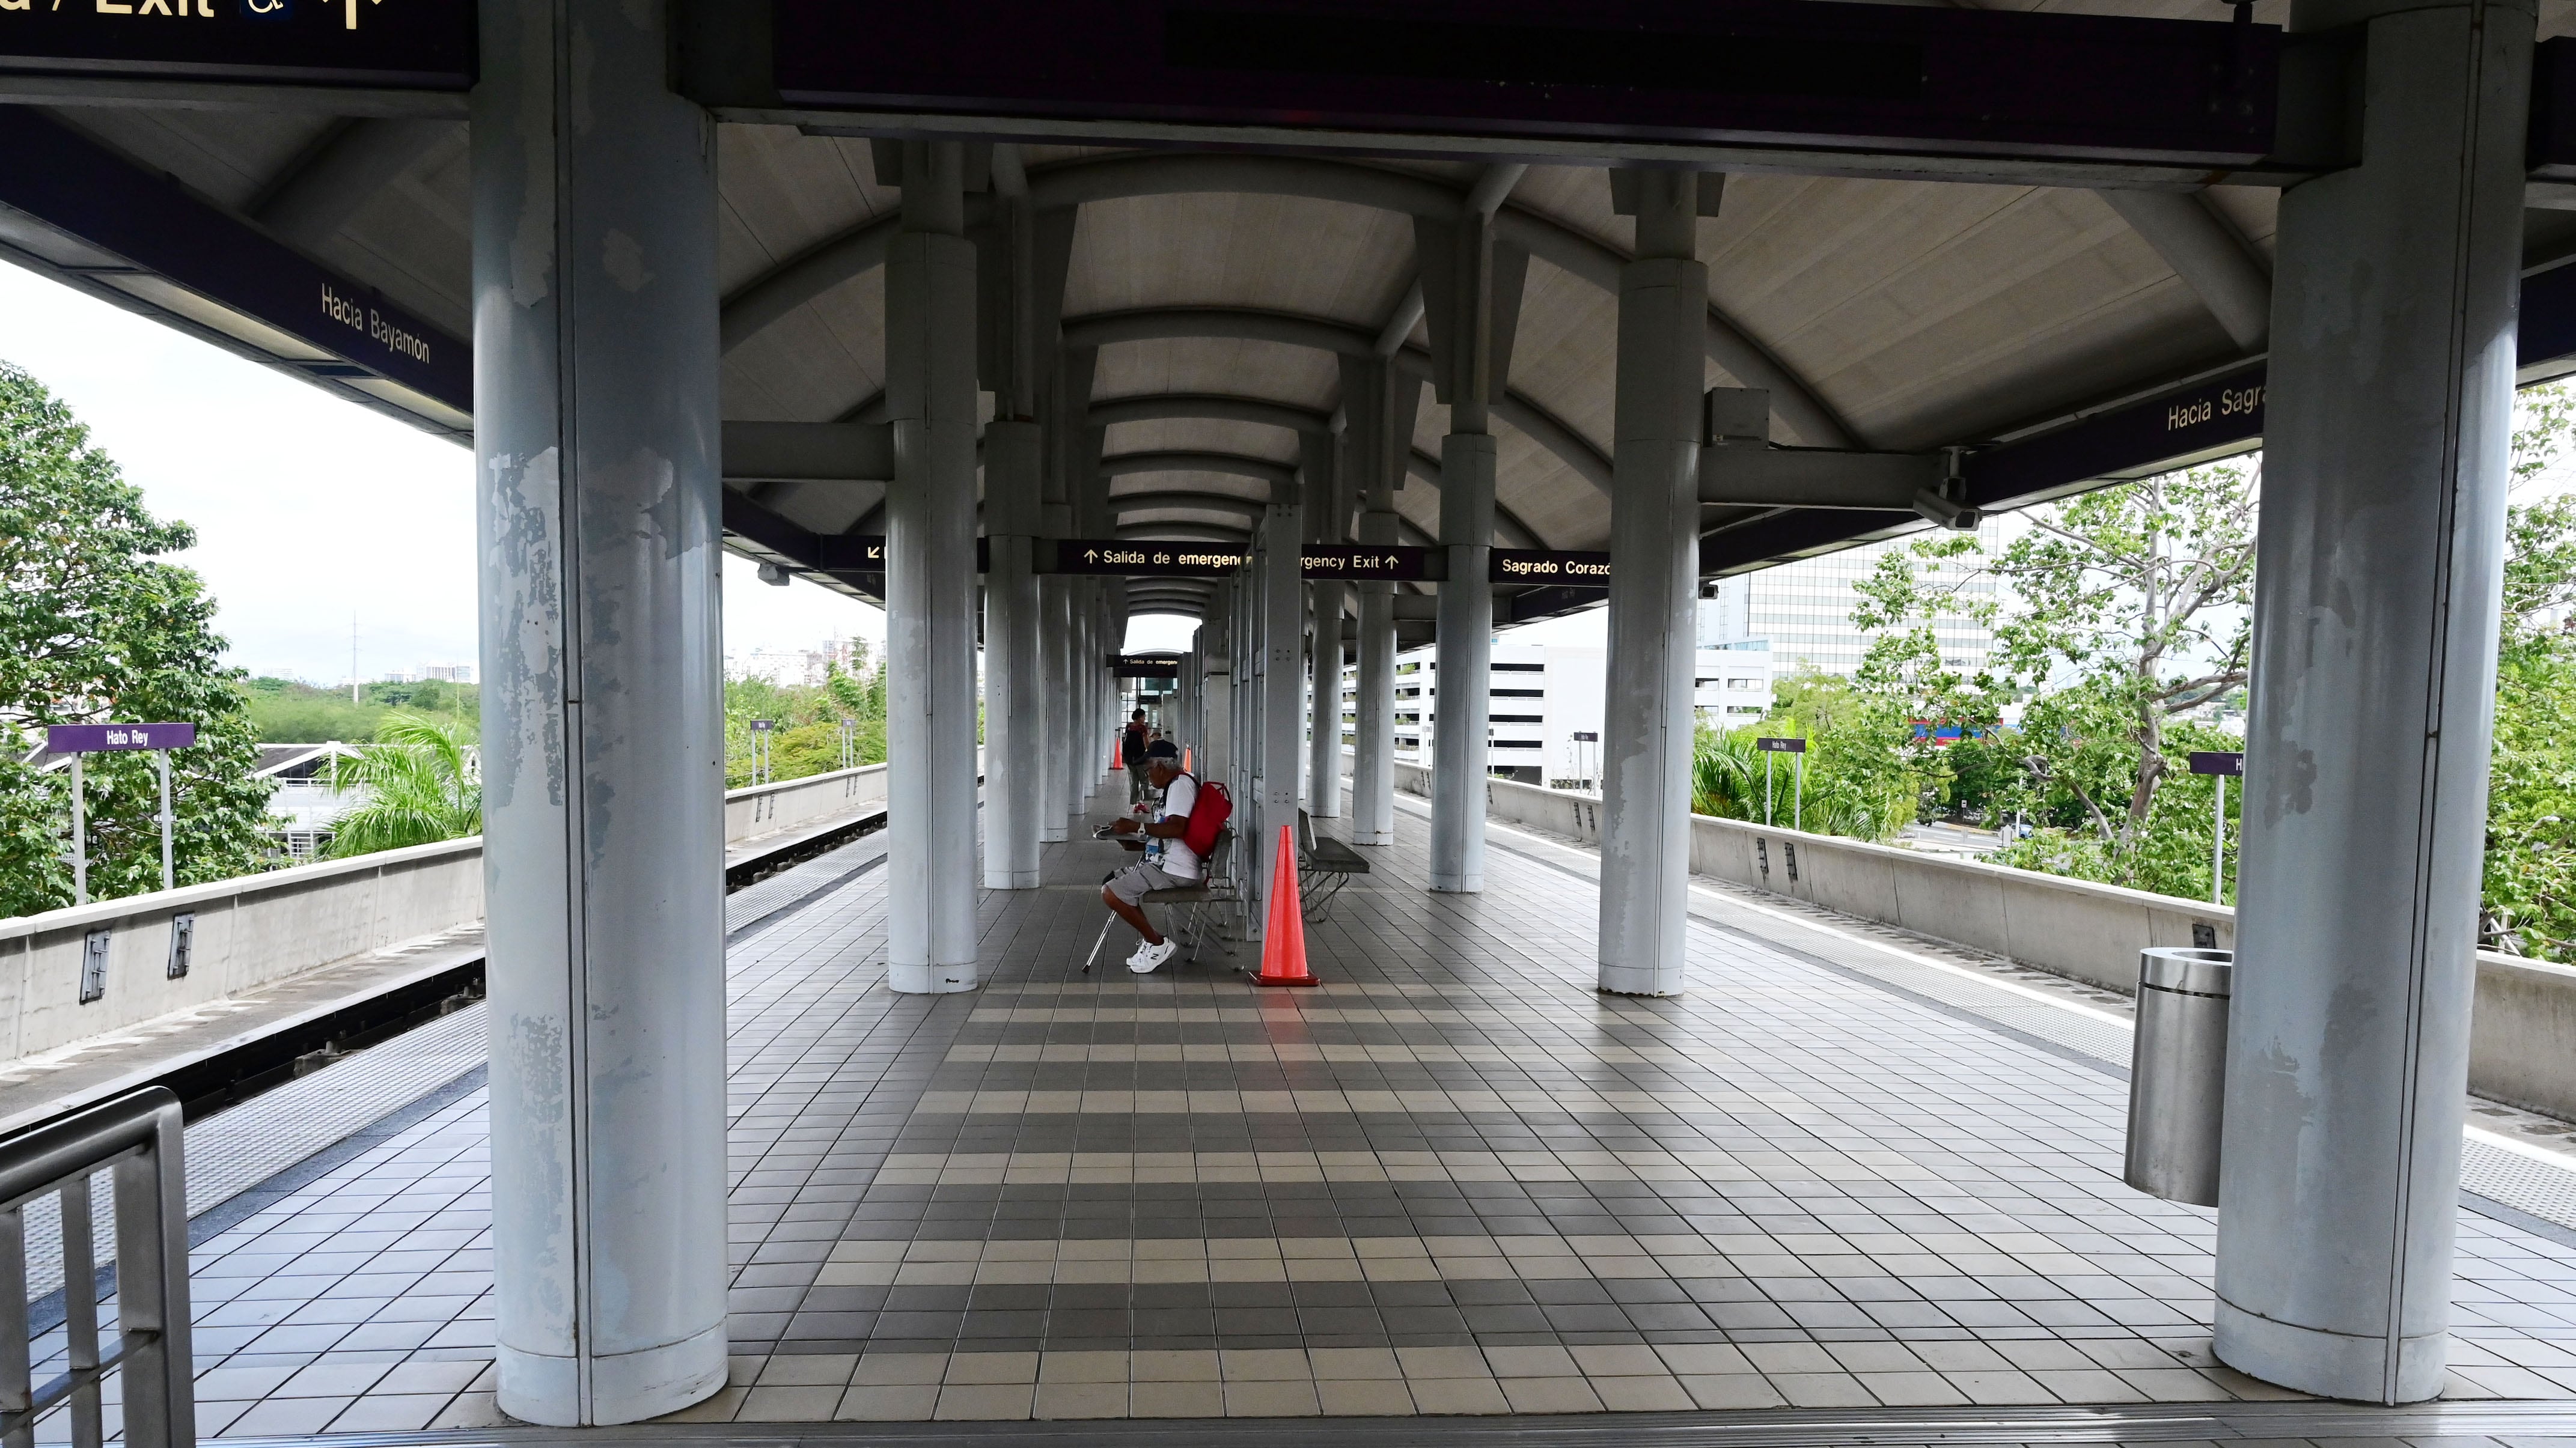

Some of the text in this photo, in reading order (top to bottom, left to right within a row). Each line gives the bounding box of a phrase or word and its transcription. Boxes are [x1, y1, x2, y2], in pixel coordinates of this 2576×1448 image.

[322, 283, 429, 364] Hacia Bayamón
[2168, 385, 2265, 431] Hacia Sagr
[1103, 550, 1253, 568] Salida de emergen
[1300, 555, 1379, 570] rgency Exit
[1503, 559, 1610, 575] Sagrado Corazó
[106, 729, 148, 747] Hato Rey
